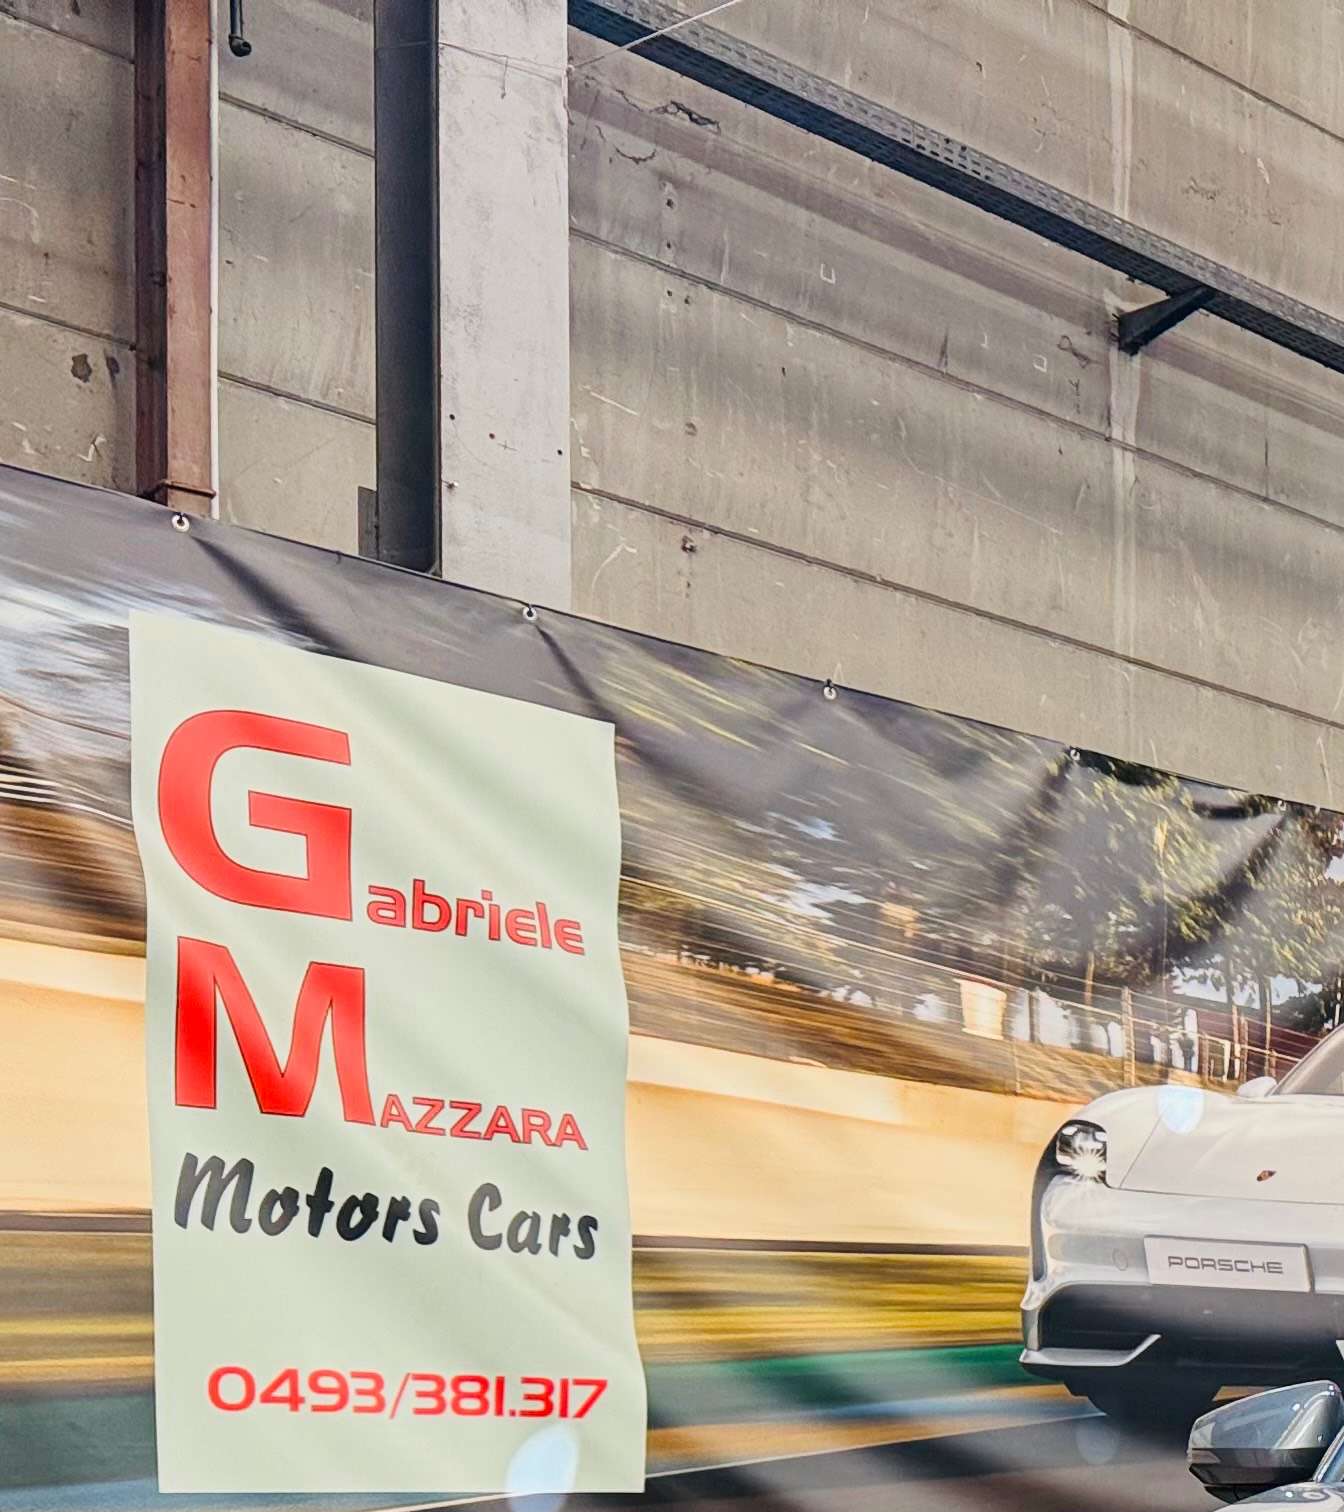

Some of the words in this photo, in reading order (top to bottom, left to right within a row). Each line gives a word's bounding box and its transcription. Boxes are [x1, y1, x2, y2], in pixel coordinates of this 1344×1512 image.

[157, 709, 585, 956] Gabriele
[172, 1150, 442, 1248] Motors
[466, 1180, 600, 1262] Cars
[1168, 1256, 1284, 1274] PORSCHE
[207, 1365, 609, 1420] 0493/381.317
